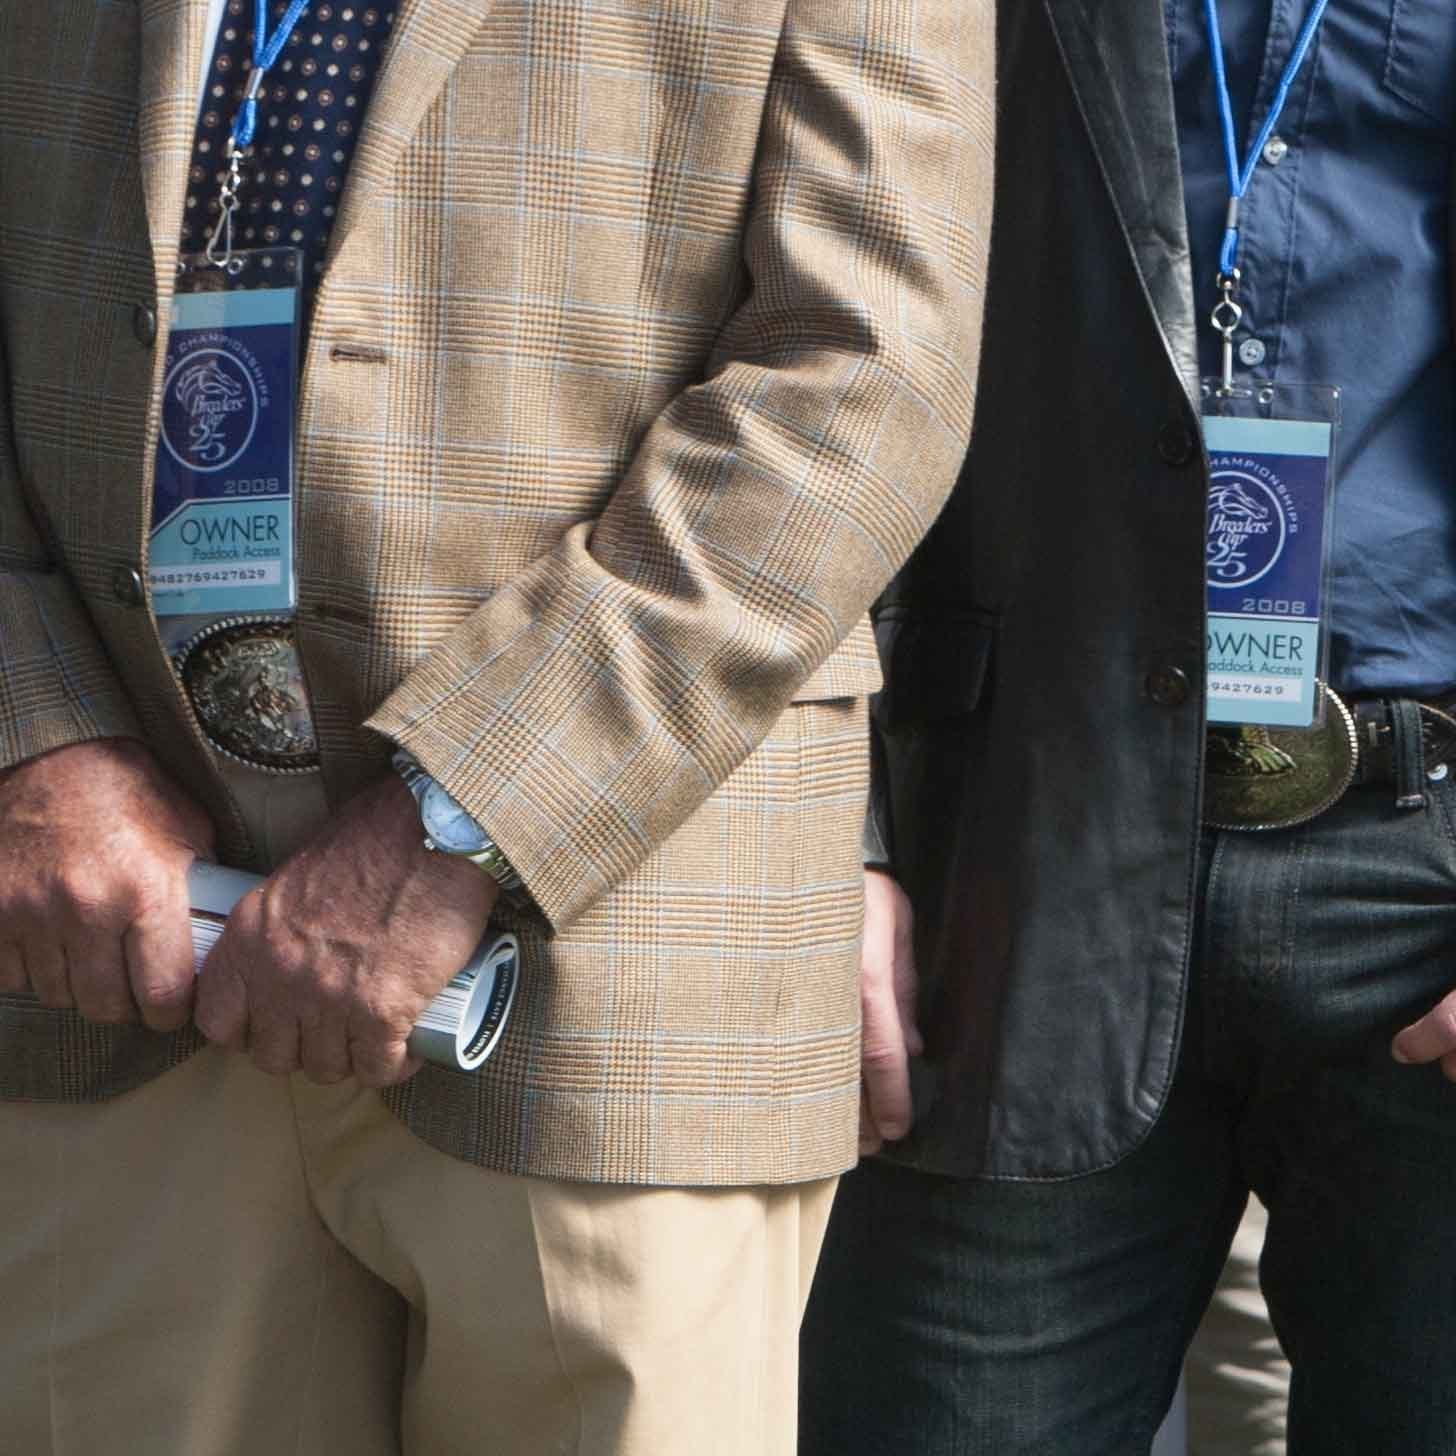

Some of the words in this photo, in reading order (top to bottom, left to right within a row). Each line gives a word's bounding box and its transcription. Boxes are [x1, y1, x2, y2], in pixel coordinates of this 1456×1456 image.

[178, 332, 270, 408] CHAMPIONSHIPS
[189, 424, 226, 461] 25
[224, 478, 279, 494] 2008
[1208, 456, 1299, 533] HAMPIONSHIPS
[180, 514, 280, 545] OWNER
[192, 546, 241, 560] Paddock
[243, 546, 281, 557] Access
[1205, 542, 1248, 578] 25
[1242, 598, 1307, 615] 2008
[1208, 657, 1255, 673] addock
[1259, 662, 1303, 676] Access
